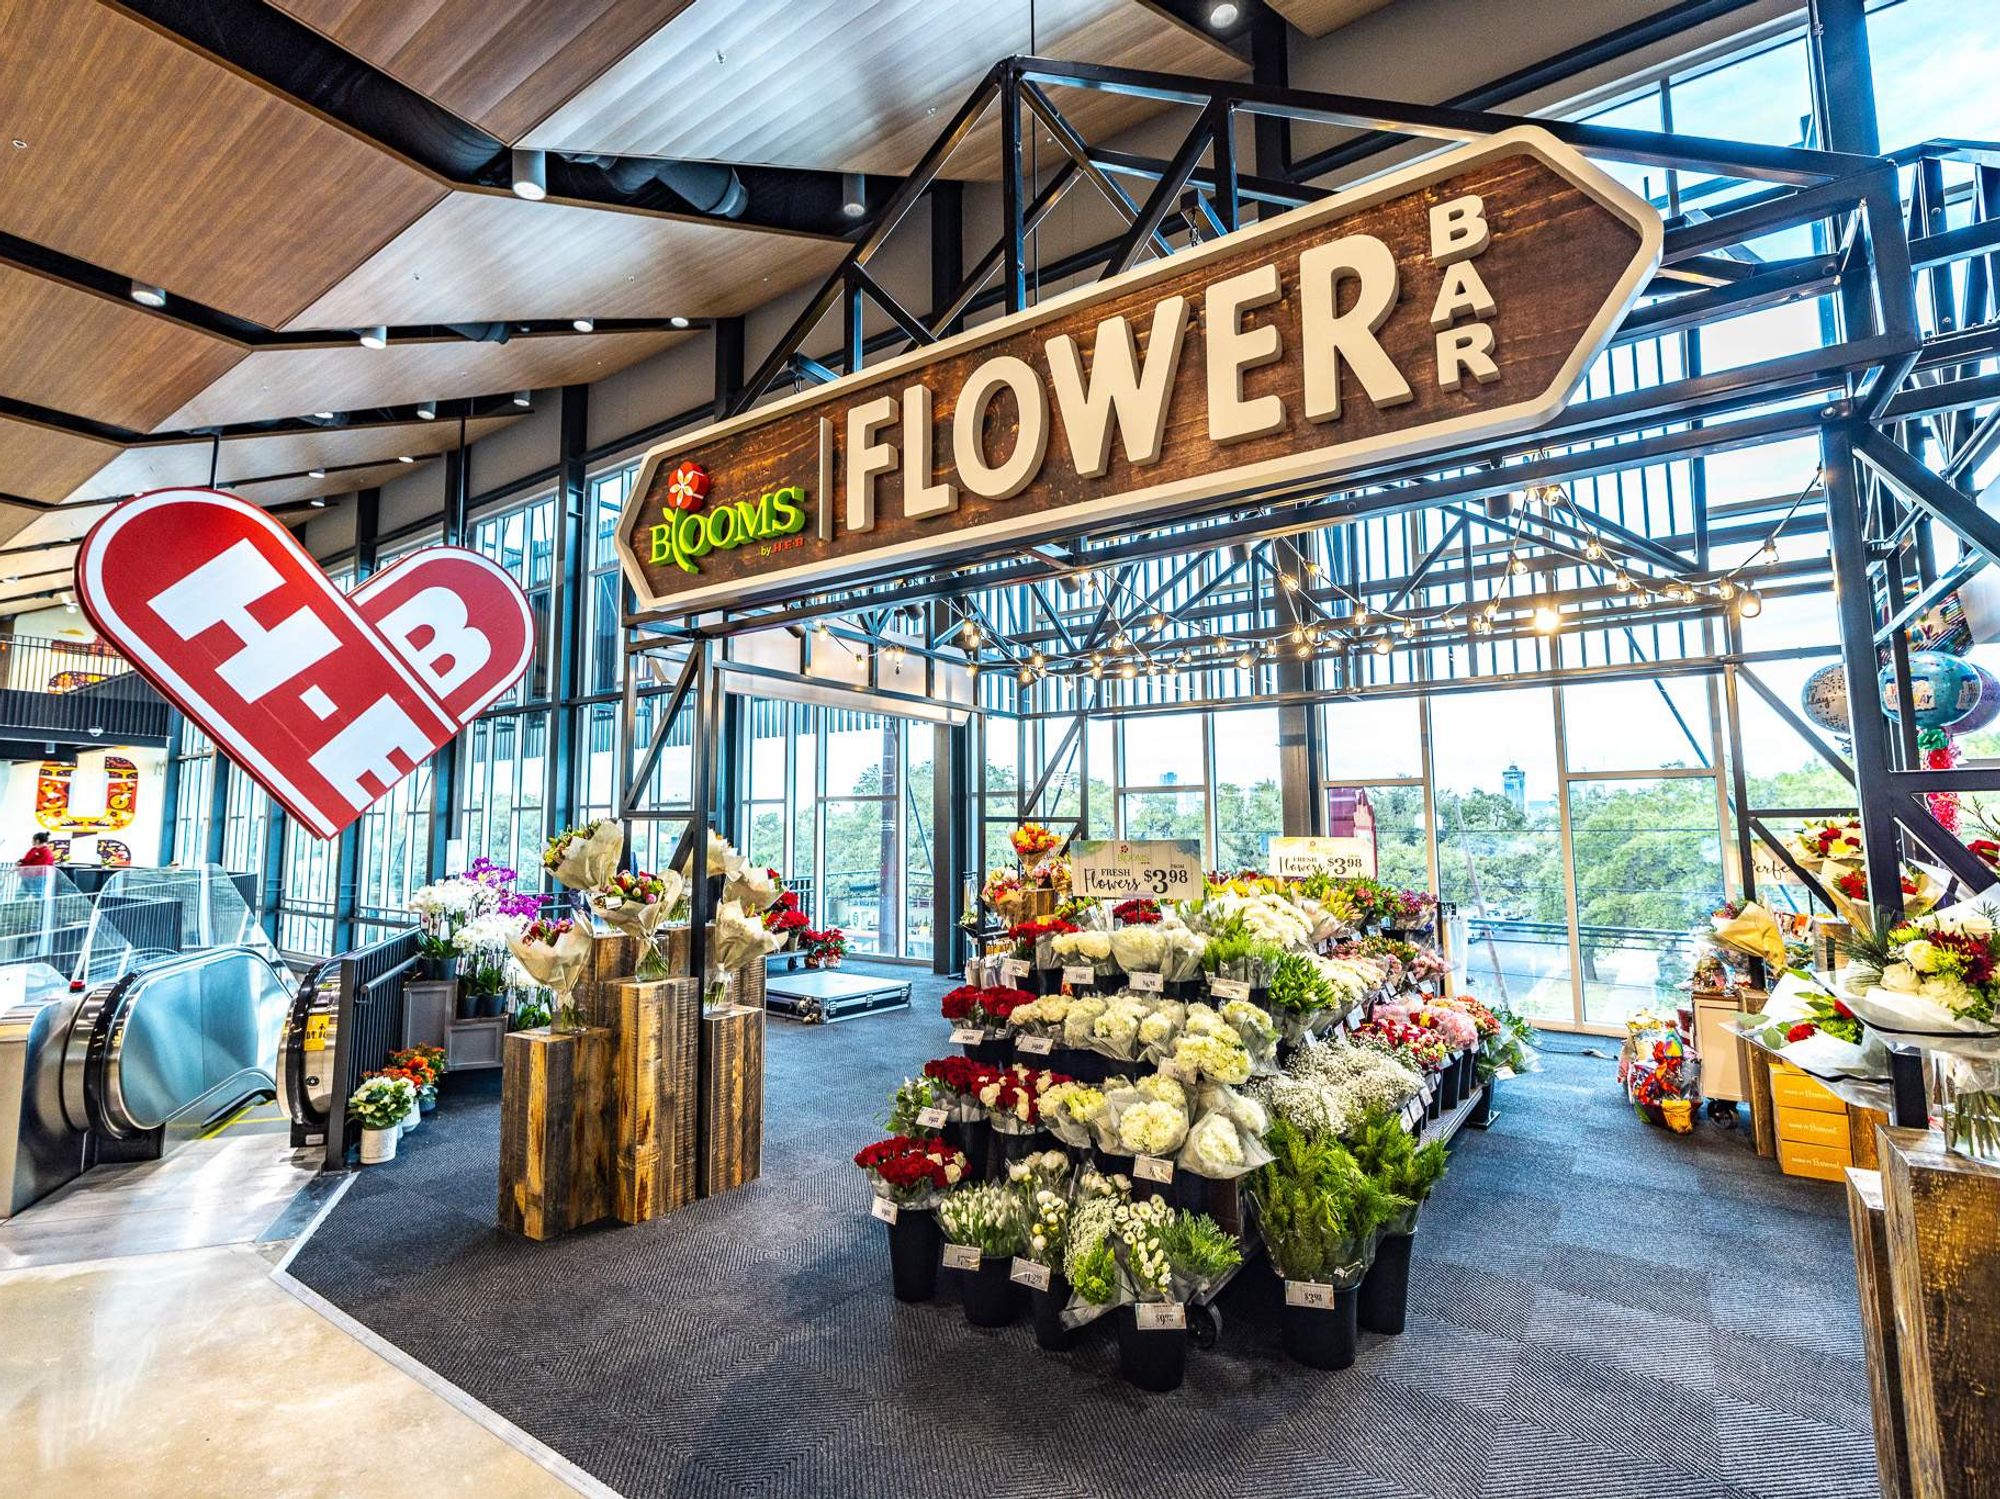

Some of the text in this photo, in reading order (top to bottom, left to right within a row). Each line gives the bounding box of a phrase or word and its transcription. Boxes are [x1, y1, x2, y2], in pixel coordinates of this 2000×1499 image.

[1429, 194, 1500, 393] BAR
[847, 234, 1414, 534] FLOWER
[648, 486, 805, 574] BLOOMS
[760, 545, 772, 557] by
[1083, 867, 1142, 893] Flowers
[1101, 868, 1131, 877] FRESH
